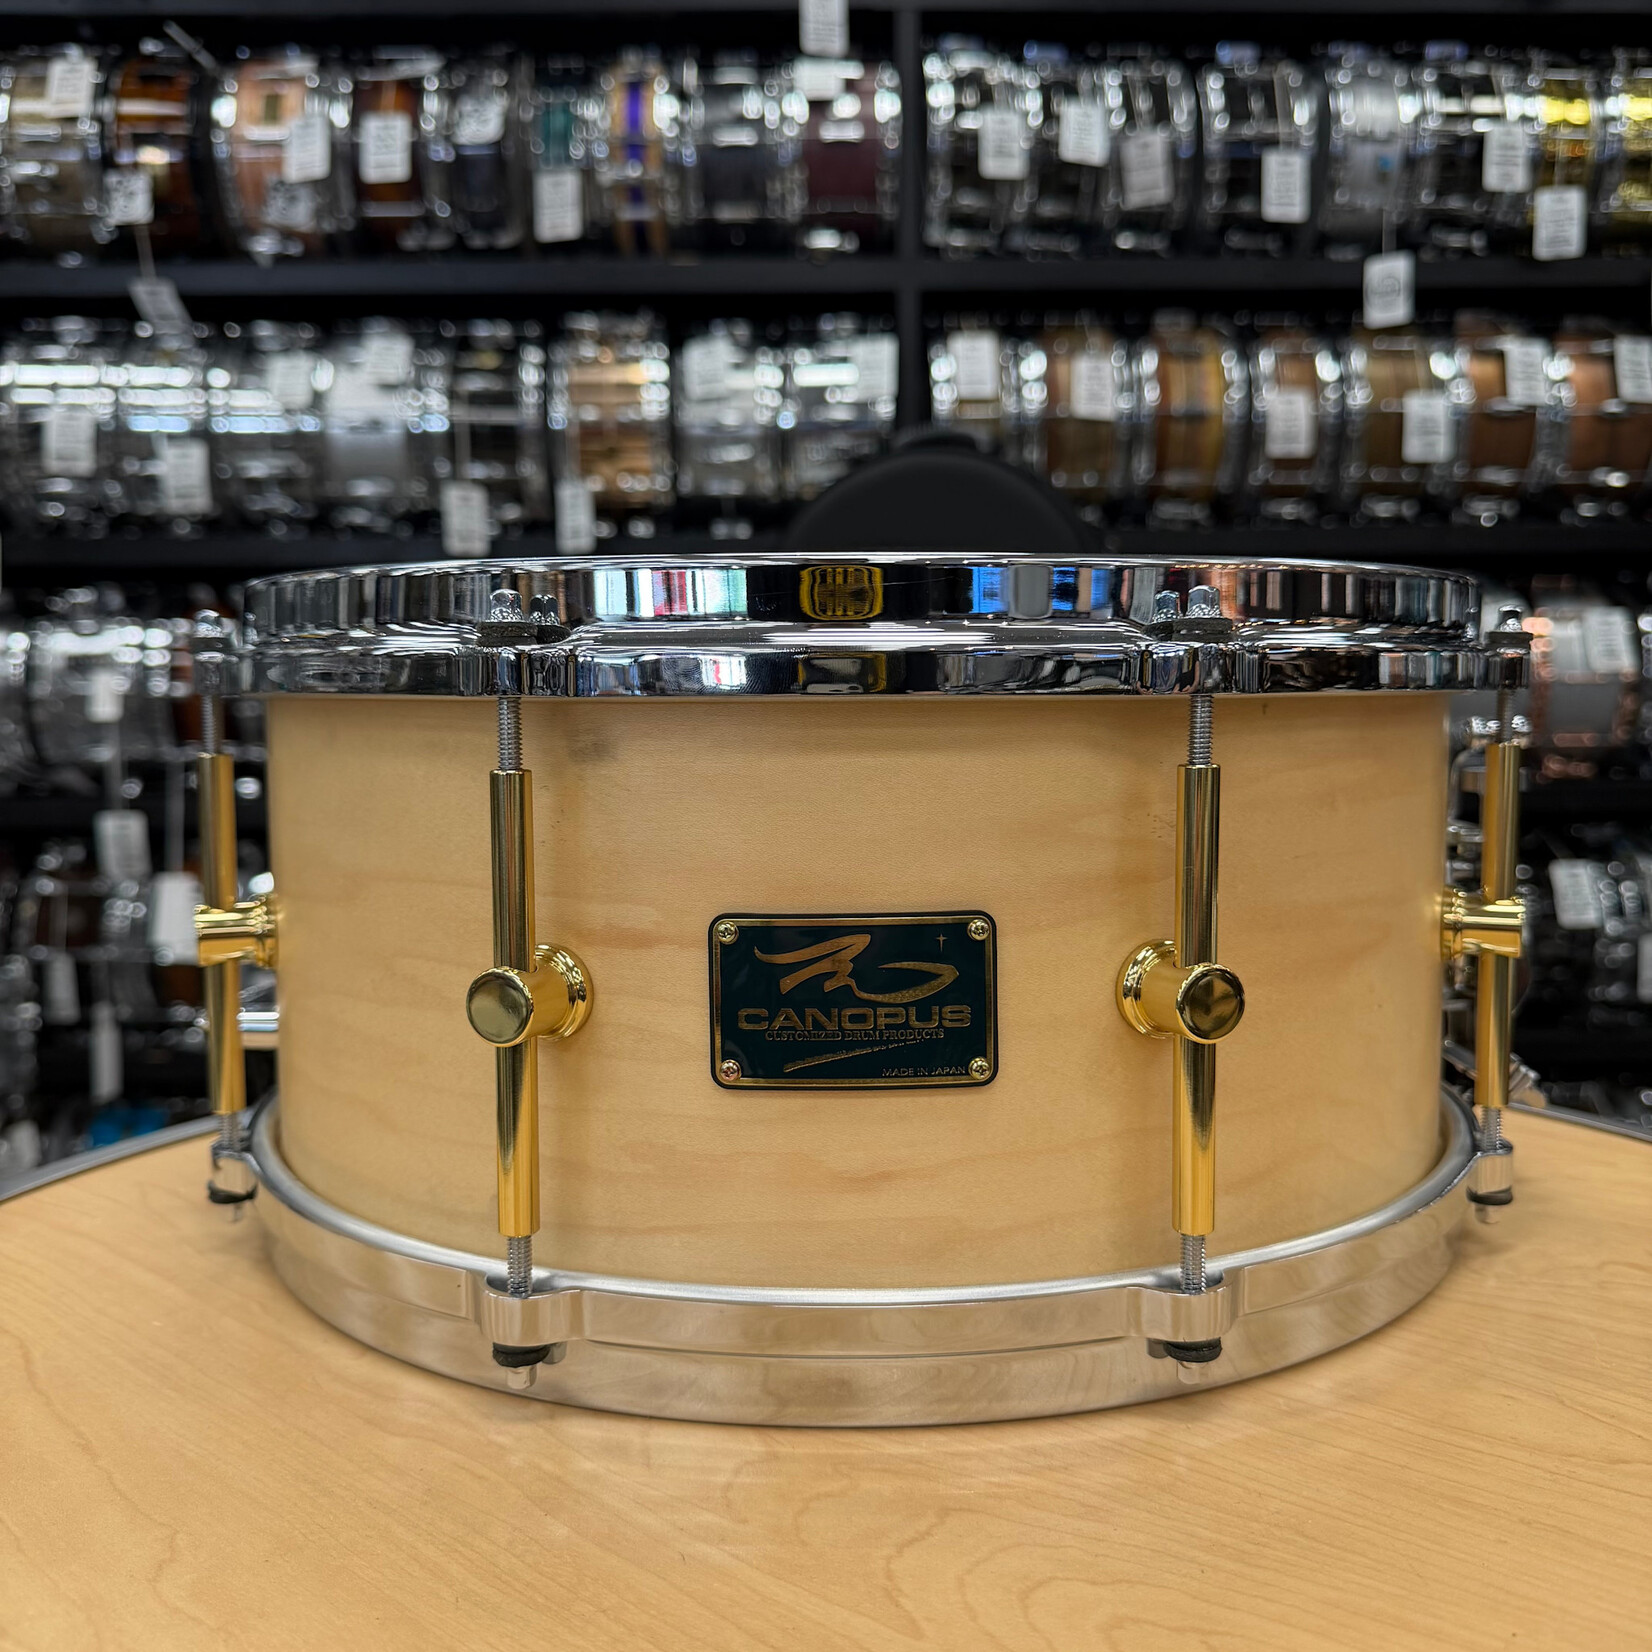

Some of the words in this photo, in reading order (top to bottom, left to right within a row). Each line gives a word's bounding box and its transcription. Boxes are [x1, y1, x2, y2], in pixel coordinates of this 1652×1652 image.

[737, 1004, 972, 1031] CANOPUS
[765, 1030, 842, 1042] CUSTOMIZED
[844, 1030, 881, 1041] DRUM
[882, 1028, 945, 1040] PRODUCTS
[881, 1067, 915, 1077] MADE
[917, 1066, 929, 1076] IN
[931, 1065, 966, 1076] JAPAN
